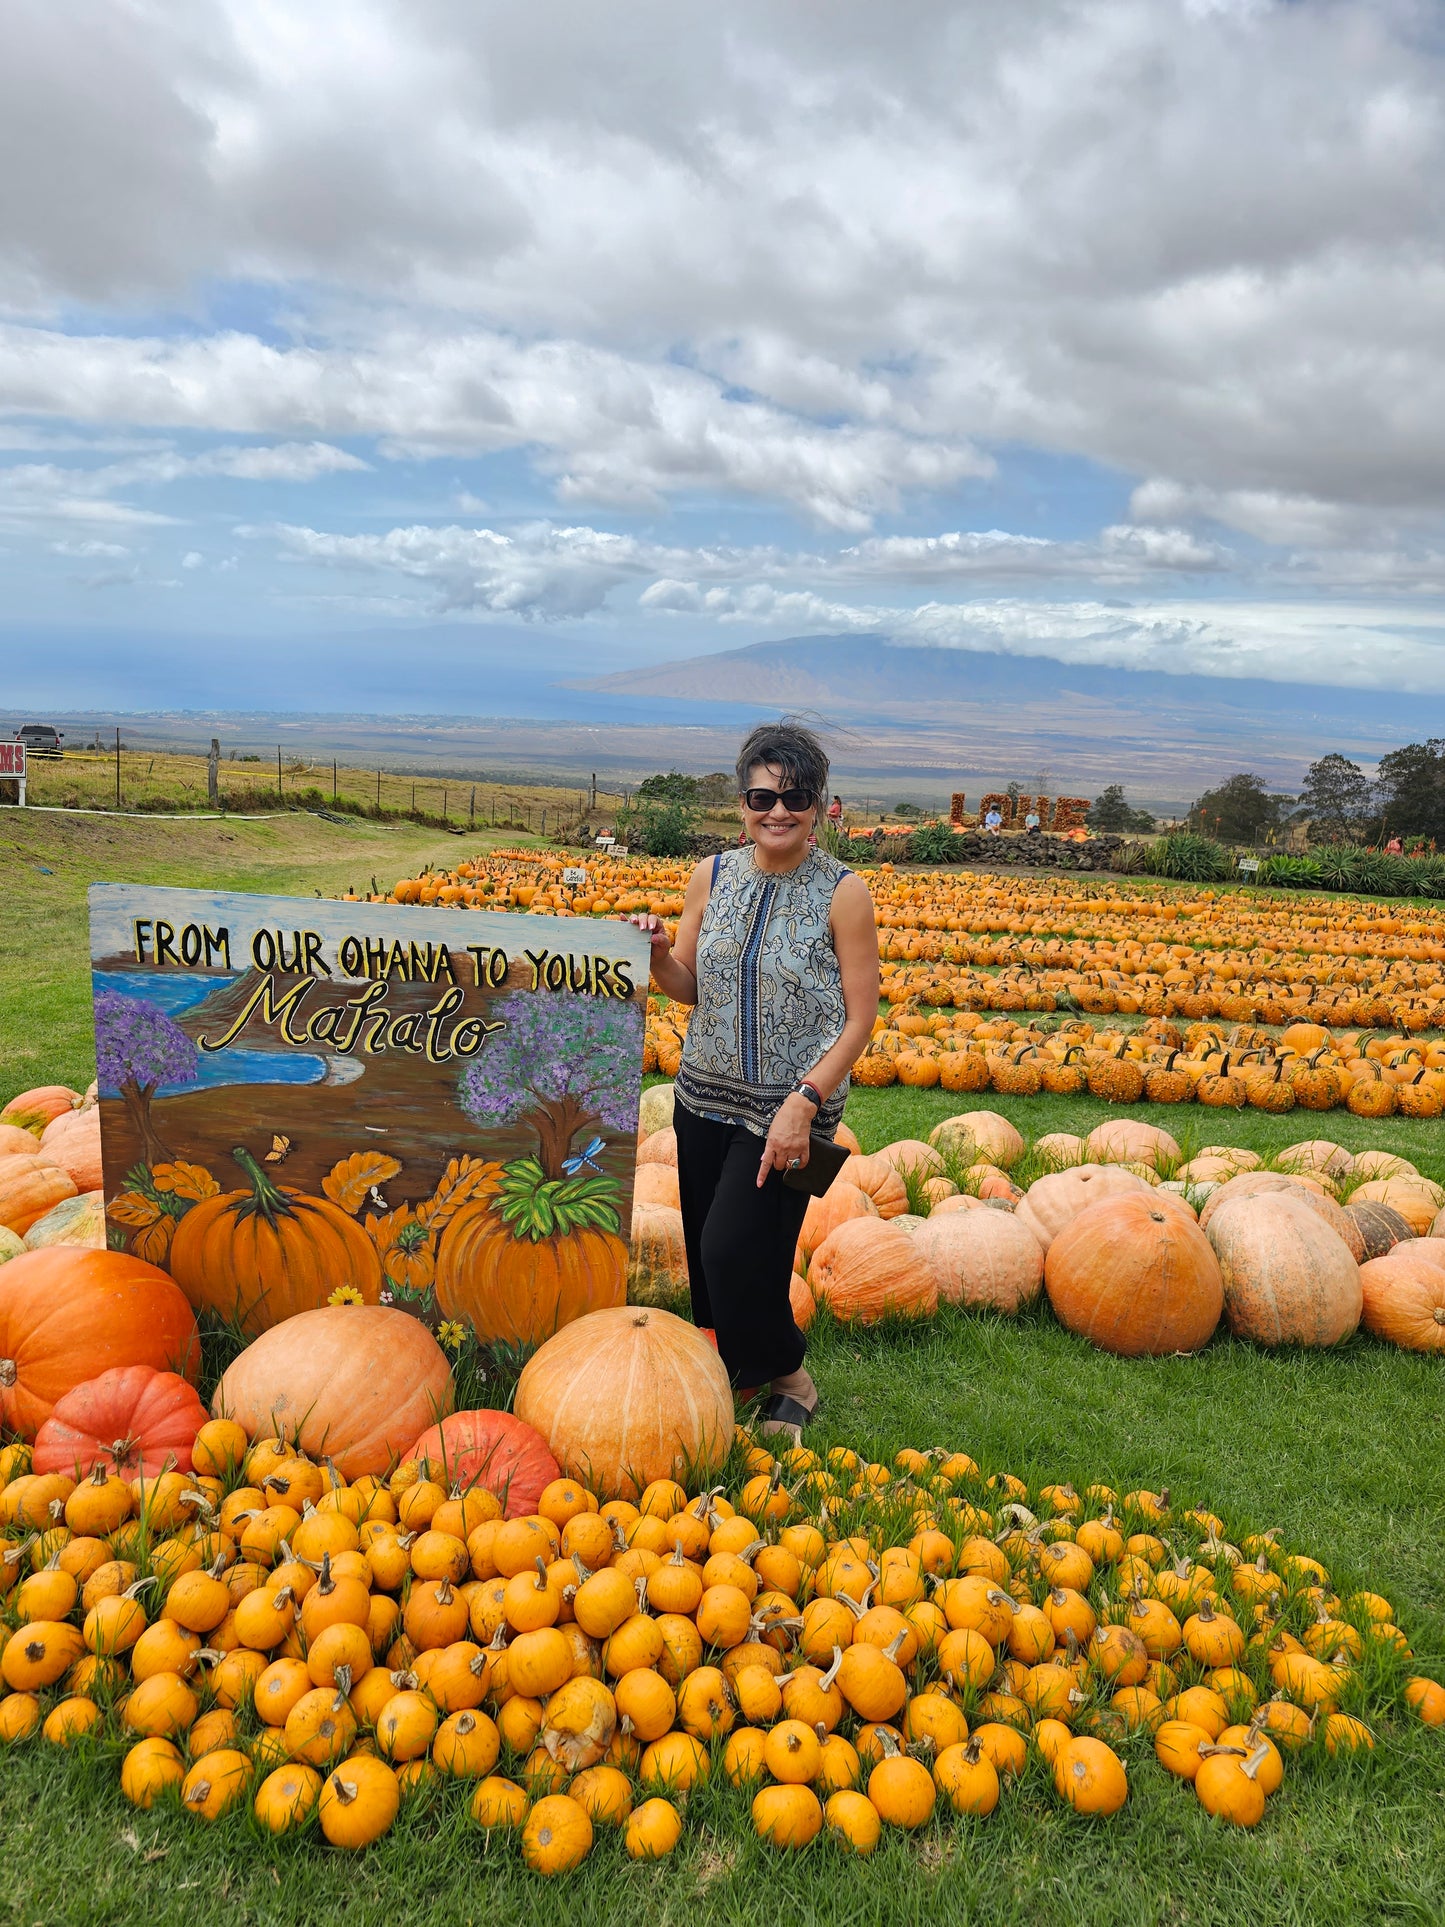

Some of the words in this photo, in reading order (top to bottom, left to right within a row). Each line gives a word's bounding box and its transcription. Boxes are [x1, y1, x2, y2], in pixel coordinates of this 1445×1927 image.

[133, 917, 231, 970] FROM
[251, 928, 333, 977] OUR
[338, 935, 458, 985] OHANA
[466, 944, 509, 989] TO
[523, 948, 636, 1000] YOURS
[197, 974, 507, 1064] Mahalo
